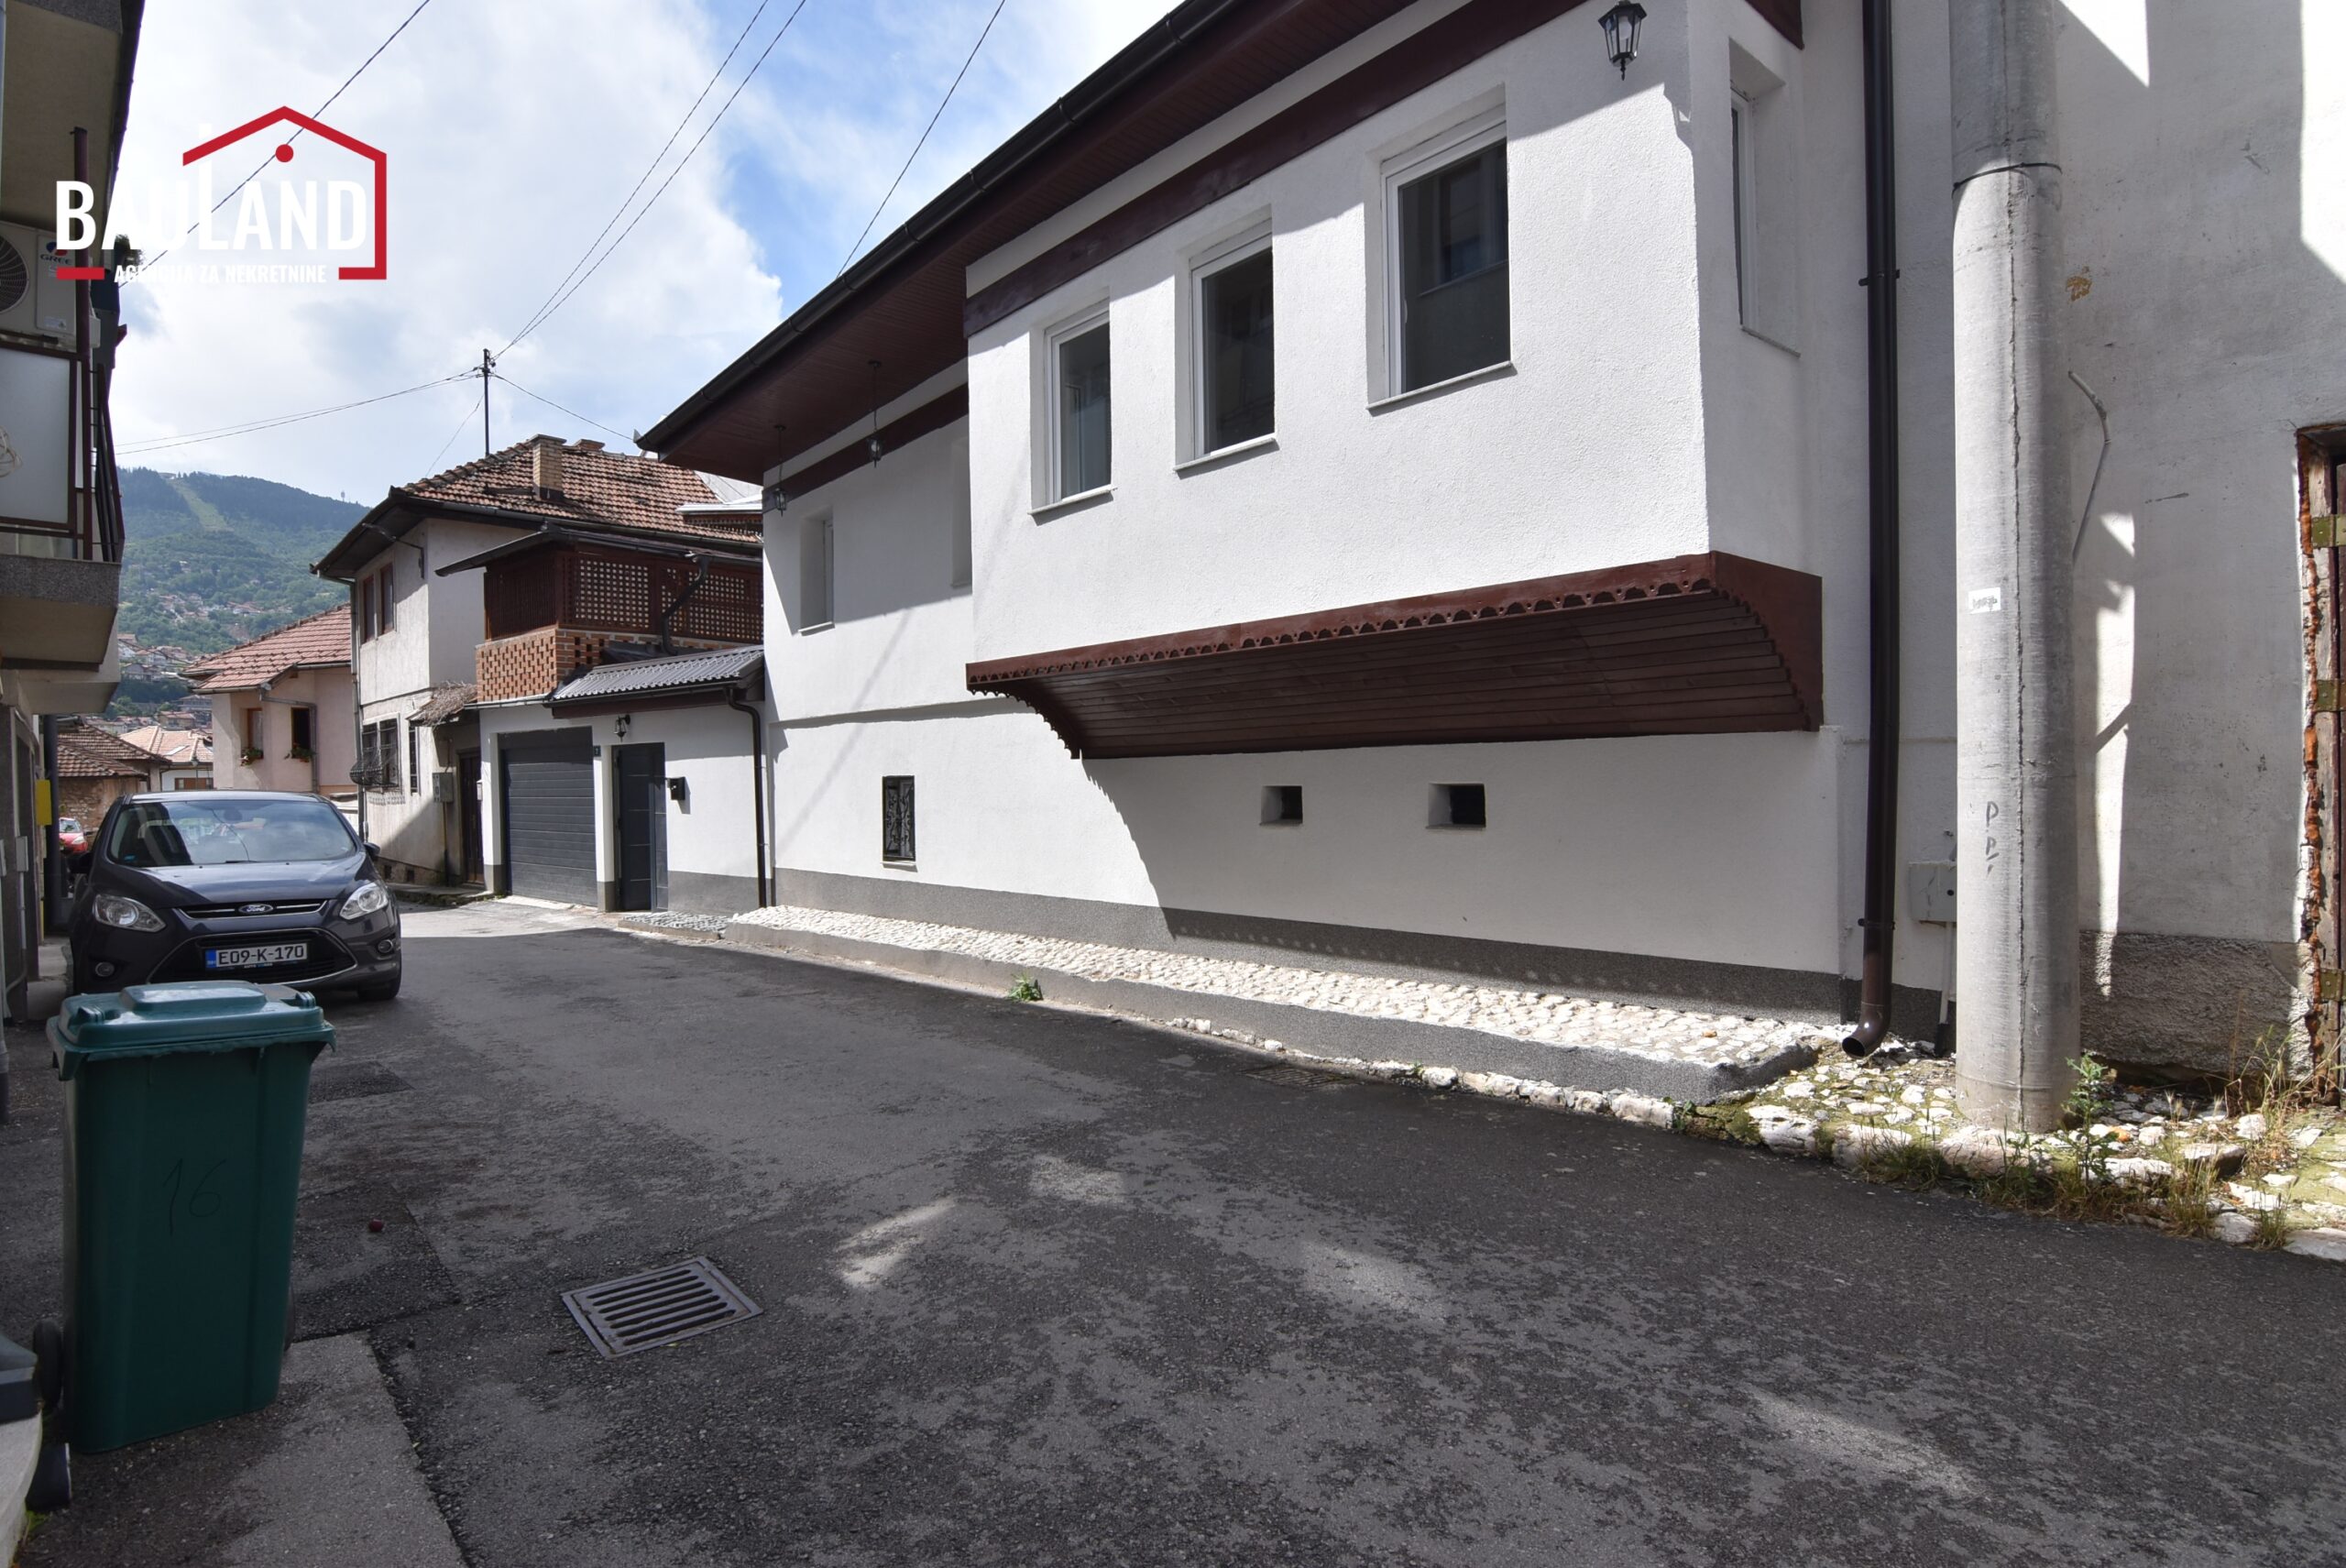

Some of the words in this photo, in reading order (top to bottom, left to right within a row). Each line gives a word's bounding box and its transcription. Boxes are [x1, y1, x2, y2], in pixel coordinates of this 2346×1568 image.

[245, 905, 266, 913] Ford
[218, 945, 305, 965] E09-K-170
[162, 1157, 227, 1237] 16
